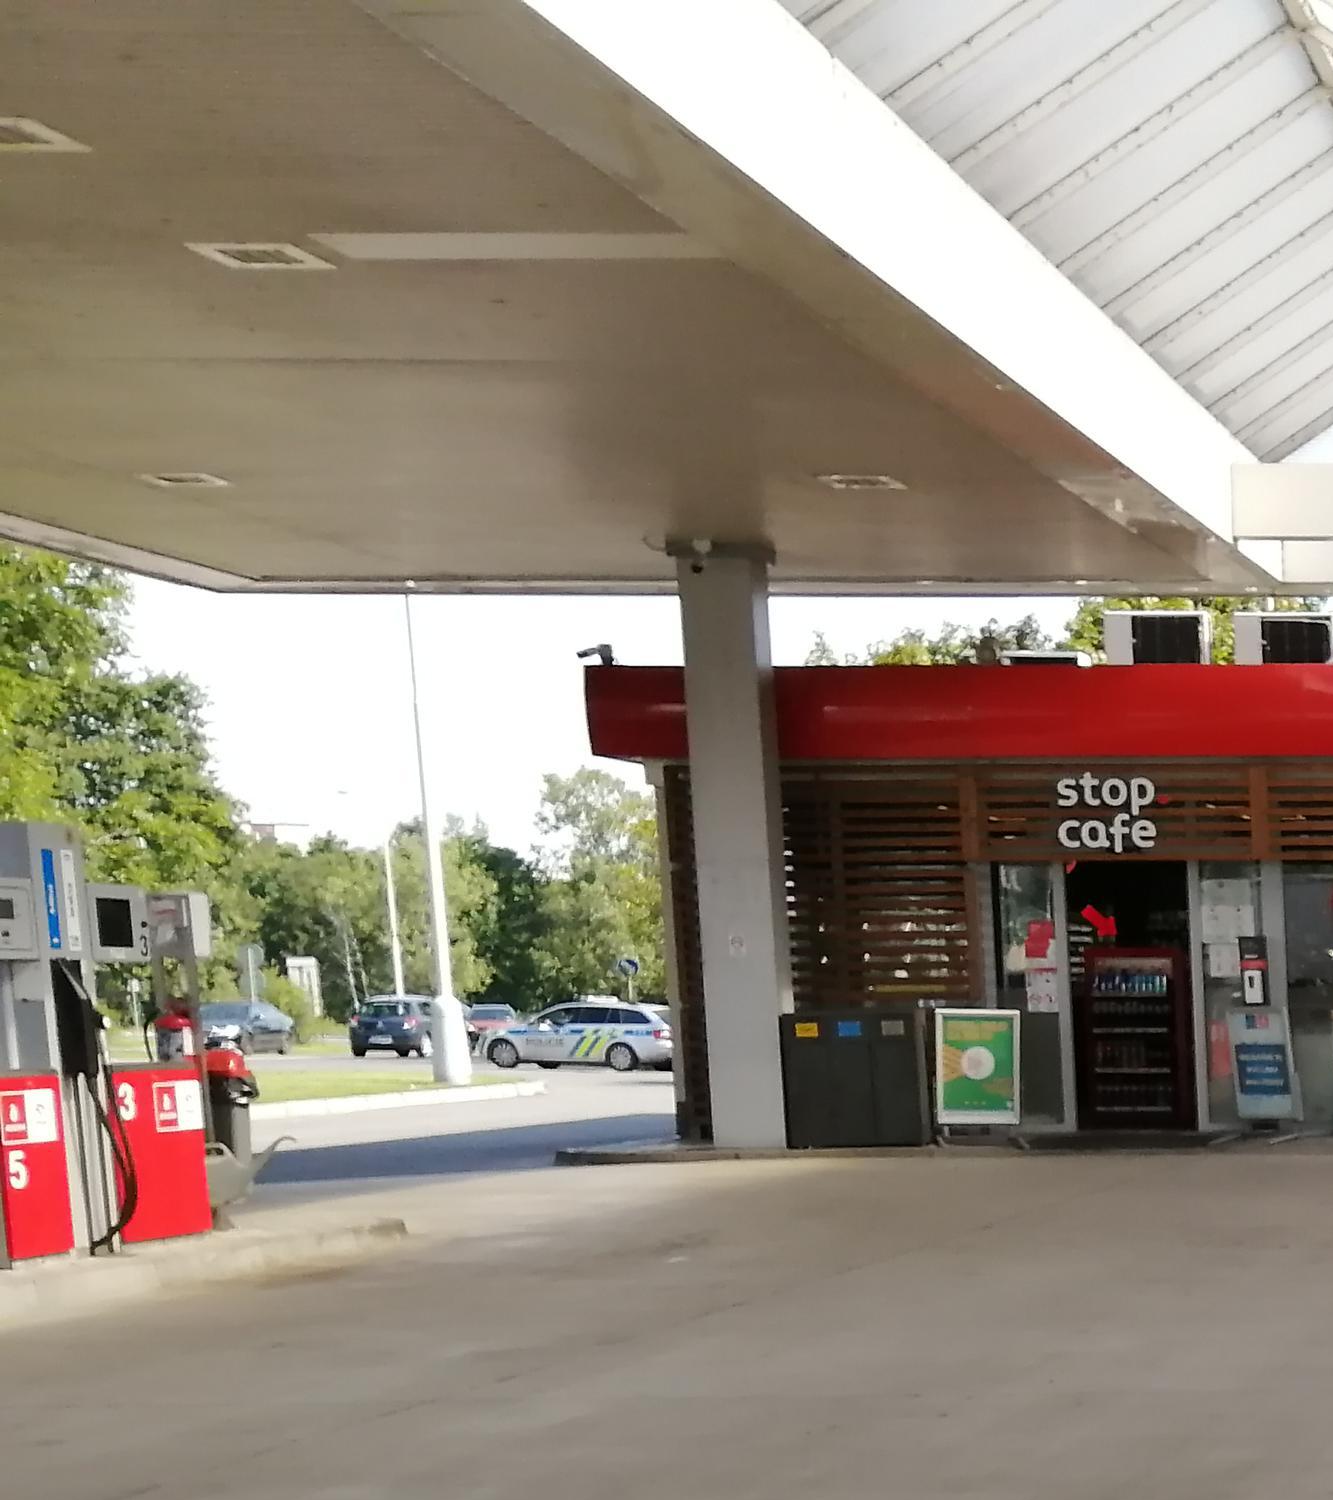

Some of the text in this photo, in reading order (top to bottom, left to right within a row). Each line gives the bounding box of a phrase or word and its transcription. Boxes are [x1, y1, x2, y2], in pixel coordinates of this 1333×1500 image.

[1057, 813, 1157, 853] cafe
[139, 934, 150, 957] 3
[118, 1083, 136, 1121] 3
[8, 1150, 29, 1190] 5
